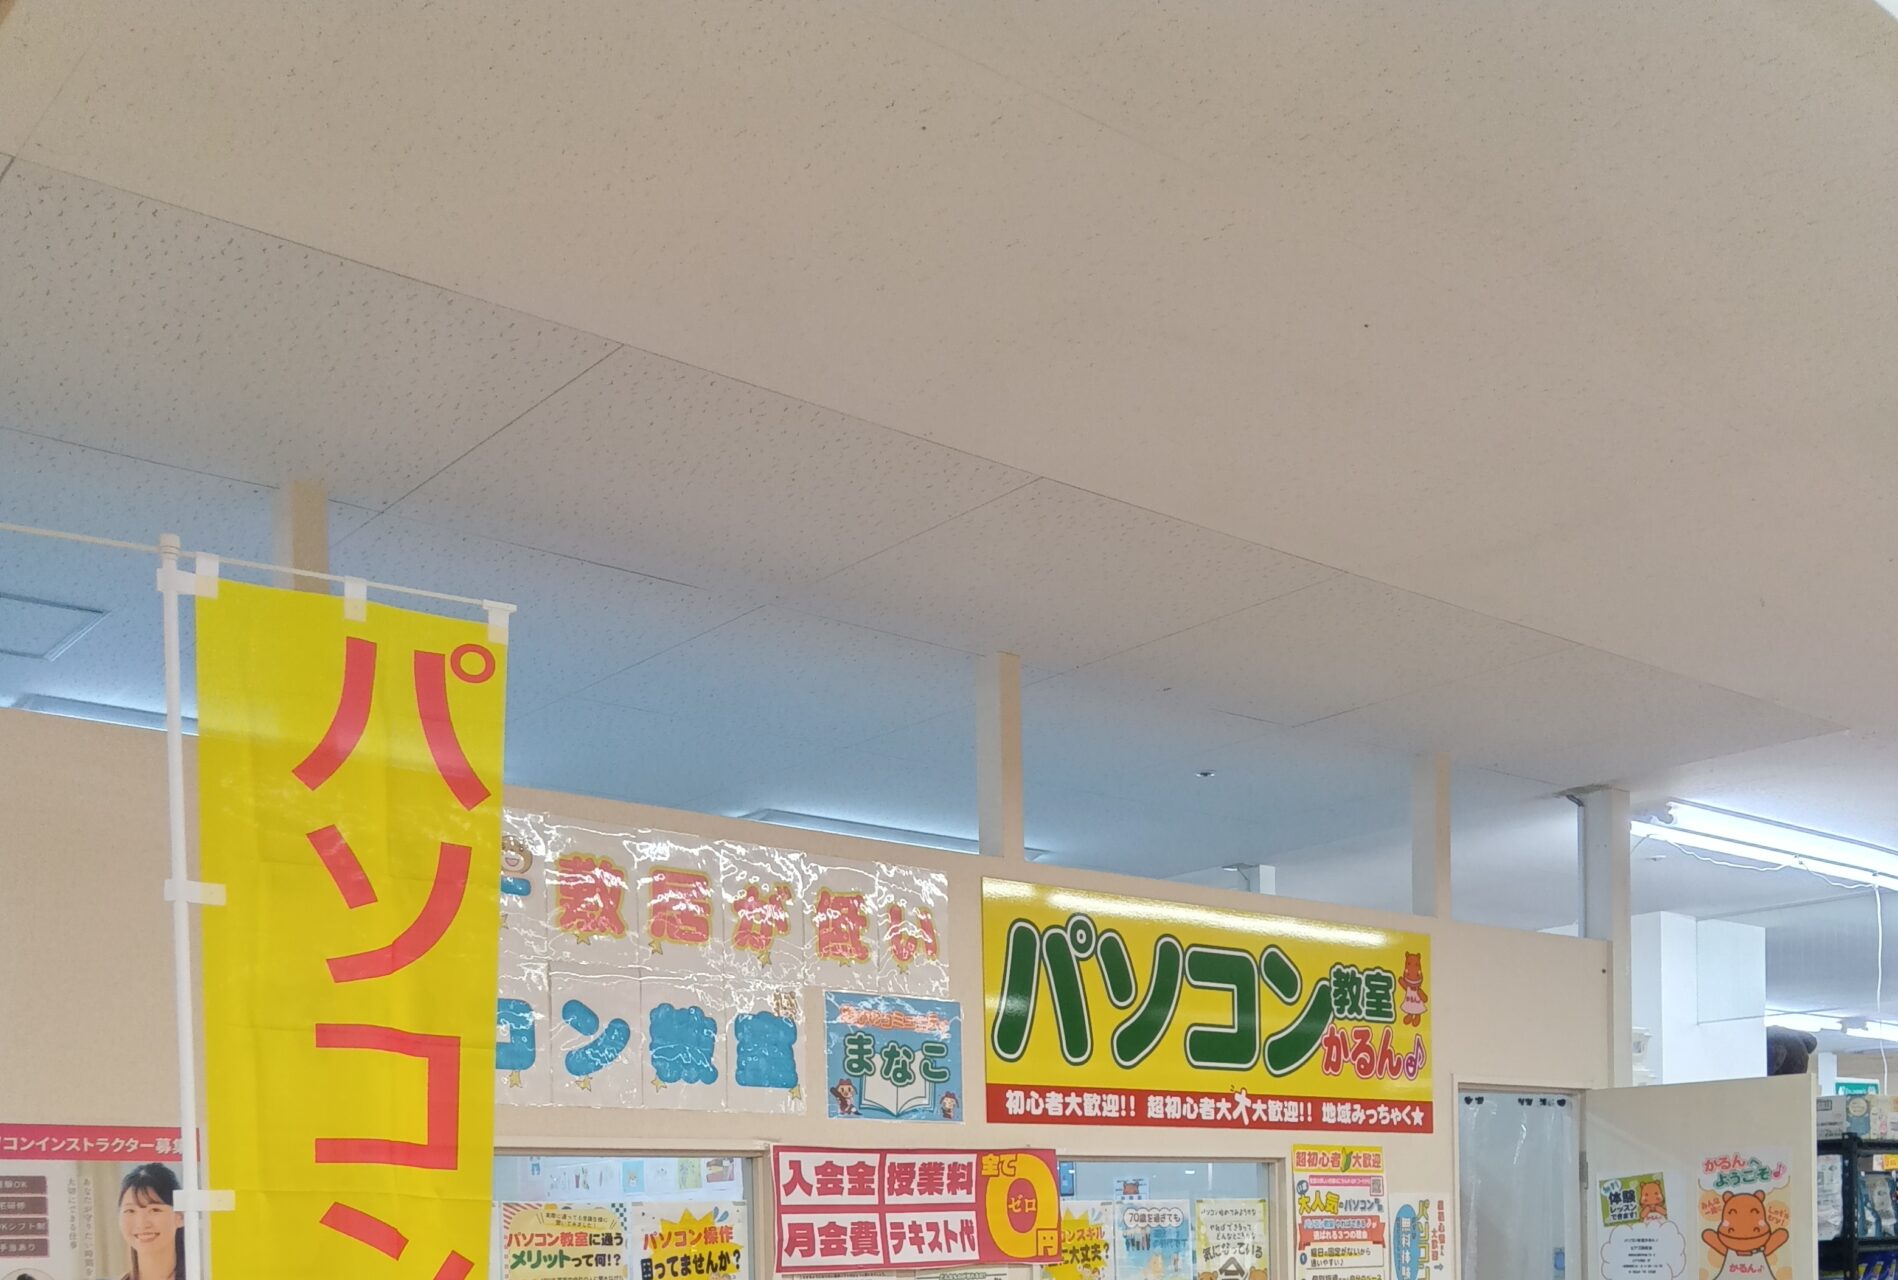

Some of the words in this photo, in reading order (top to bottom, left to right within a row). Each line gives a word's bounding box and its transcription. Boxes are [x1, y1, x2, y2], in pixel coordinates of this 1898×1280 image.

[844, 1031, 951, 1087] まなこ
[0, 1136, 182, 1155] コンインストラクター募集
[981, 1153, 1018, 1178] 全て
[1714, 1166, 1771, 1188] ようこそ
[783, 1160, 877, 1197] 入会金
[887, 1161, 975, 1197] 授業料
[1008, 1195, 1038, 1213] ゼロ
[1608, 1189, 1636, 1206] 体験
[1609, 1204, 1638, 1214] レッスン
[506, 1231, 624, 1248] パソコン教室に通う
[643, 1225, 734, 1251] パソコン操作
[785, 1221, 881, 1257] 月会費
[889, 1219, 977, 1255] テキスト代
[1037, 1229, 1062, 1257] 円
